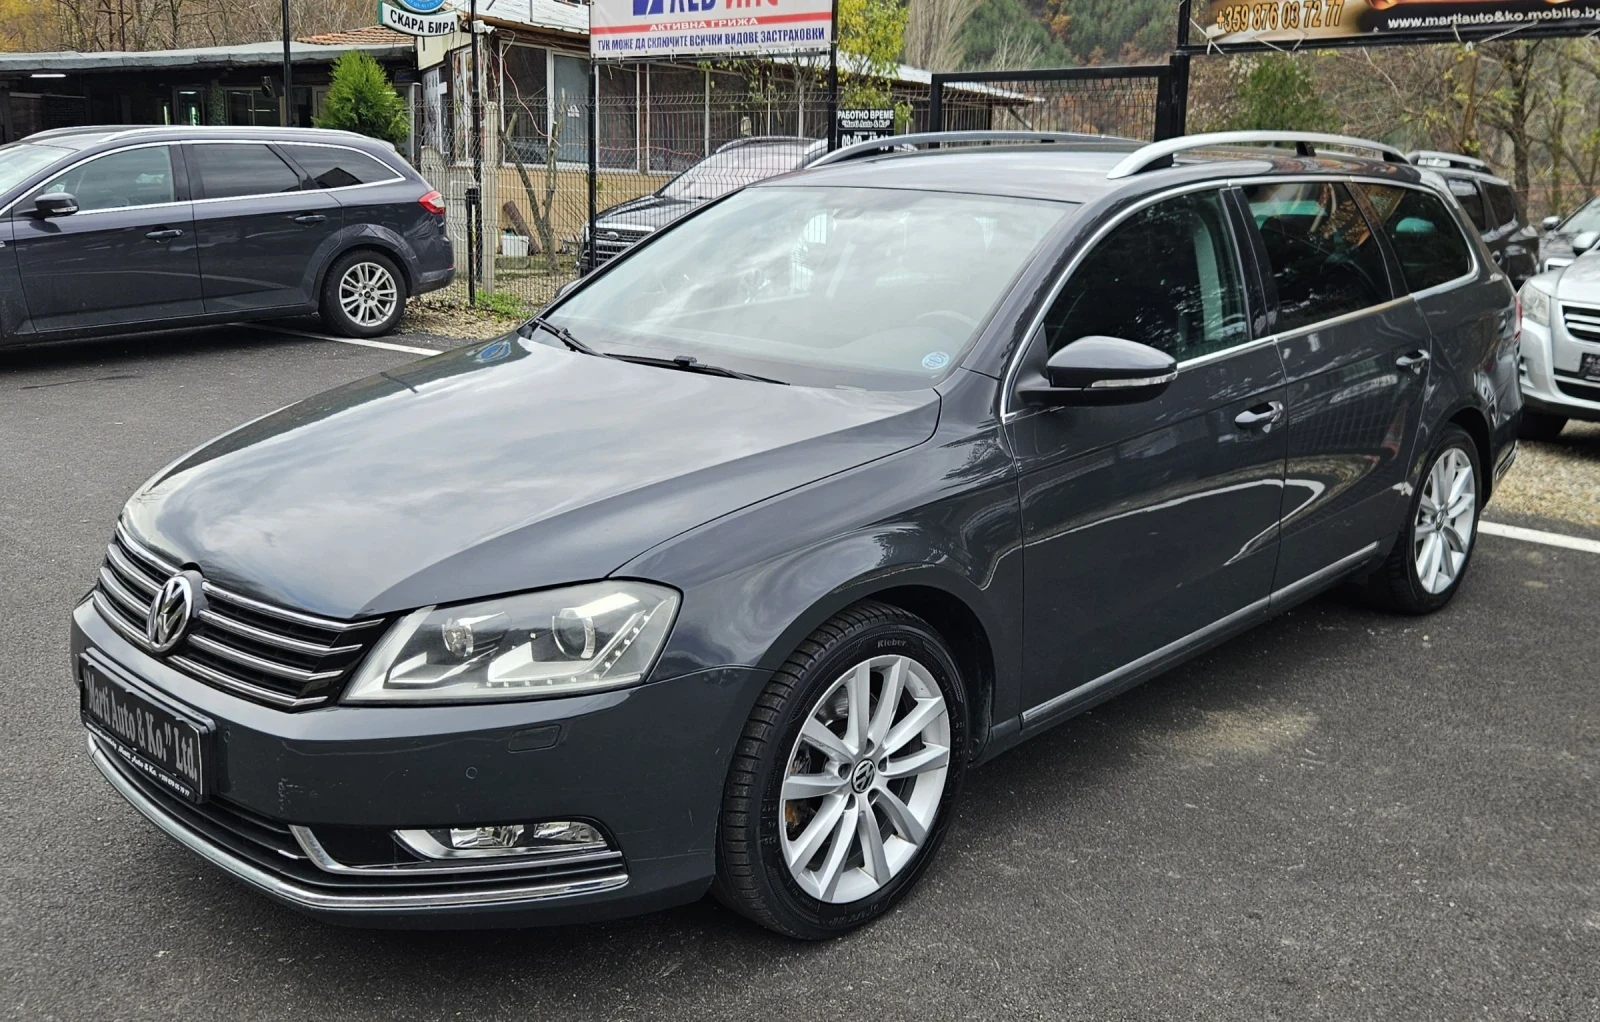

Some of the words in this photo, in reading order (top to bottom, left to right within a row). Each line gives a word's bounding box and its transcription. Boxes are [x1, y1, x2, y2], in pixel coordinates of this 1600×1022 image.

[391, 9, 424, 33] СКАРА
[428, 21, 455, 33] БИРА
[650, 21, 707, 31] АКТИВНА
[711, 17, 758, 28] ГРИЖА
[1216, 4, 1249, 33] +359
[1252, 2, 1279, 30] 876
[1281, 1, 1300, 29] 03
[1304, 0, 1322, 28] 72
[1325, 0, 1345, 27] 77
[598, 40, 610, 51] ТУК
[611, 38, 633, 50] МОЖЕ
[635, 37, 646, 50] ДА
[647, 35, 688, 49] СКЛЮЧИТЕ
[690, 32, 722, 46] ВСИЧКИ
[725, 31, 759, 45] ВИДОВЕ
[761, 27, 825, 43] ЗАСТРАХОВКИ
[837, 110, 869, 119] РАБОТНО
[870, 110, 894, 119] ВРЕМЕ
[877, 638, 907, 648] Kleber
[111, 690, 136, 742] Auto
[136, 707, 146, 749] &
